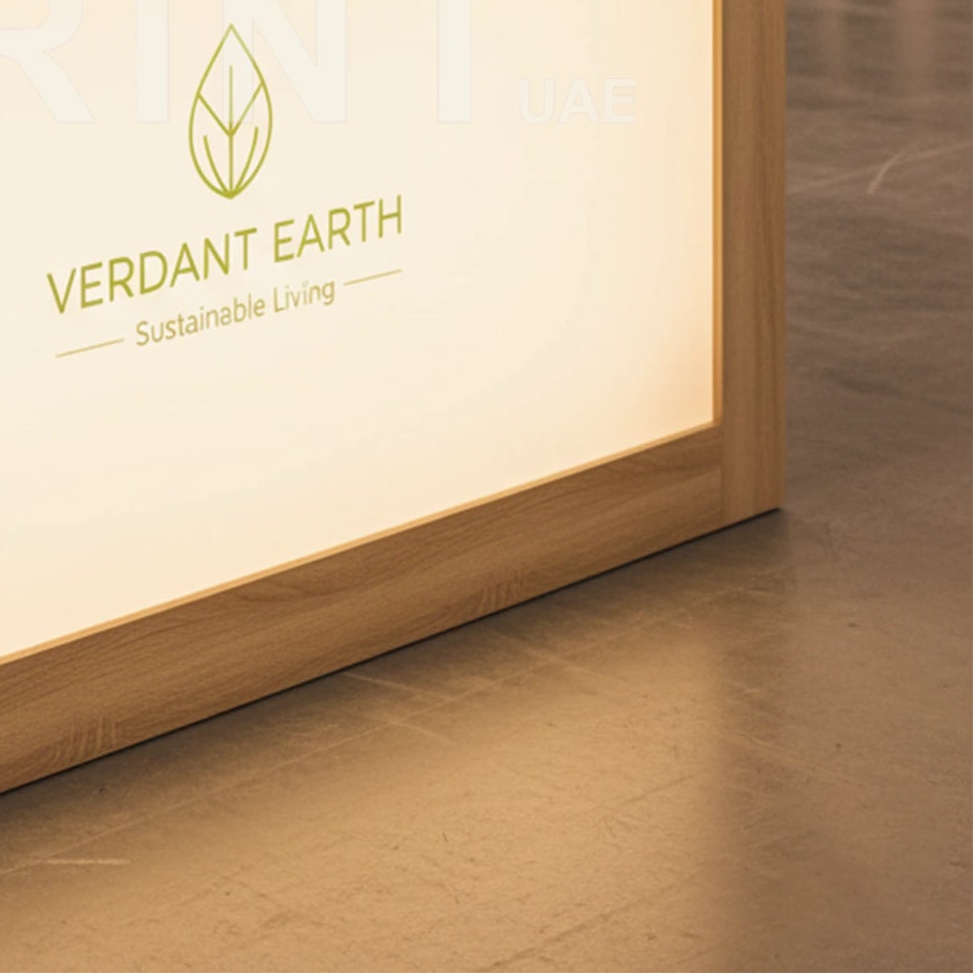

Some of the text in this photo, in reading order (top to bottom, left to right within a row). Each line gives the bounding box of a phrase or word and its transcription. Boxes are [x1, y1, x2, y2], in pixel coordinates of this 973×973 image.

[46, 194, 402, 314] VERDANT EARTH
[135, 279, 336, 347] Sustainable Living
